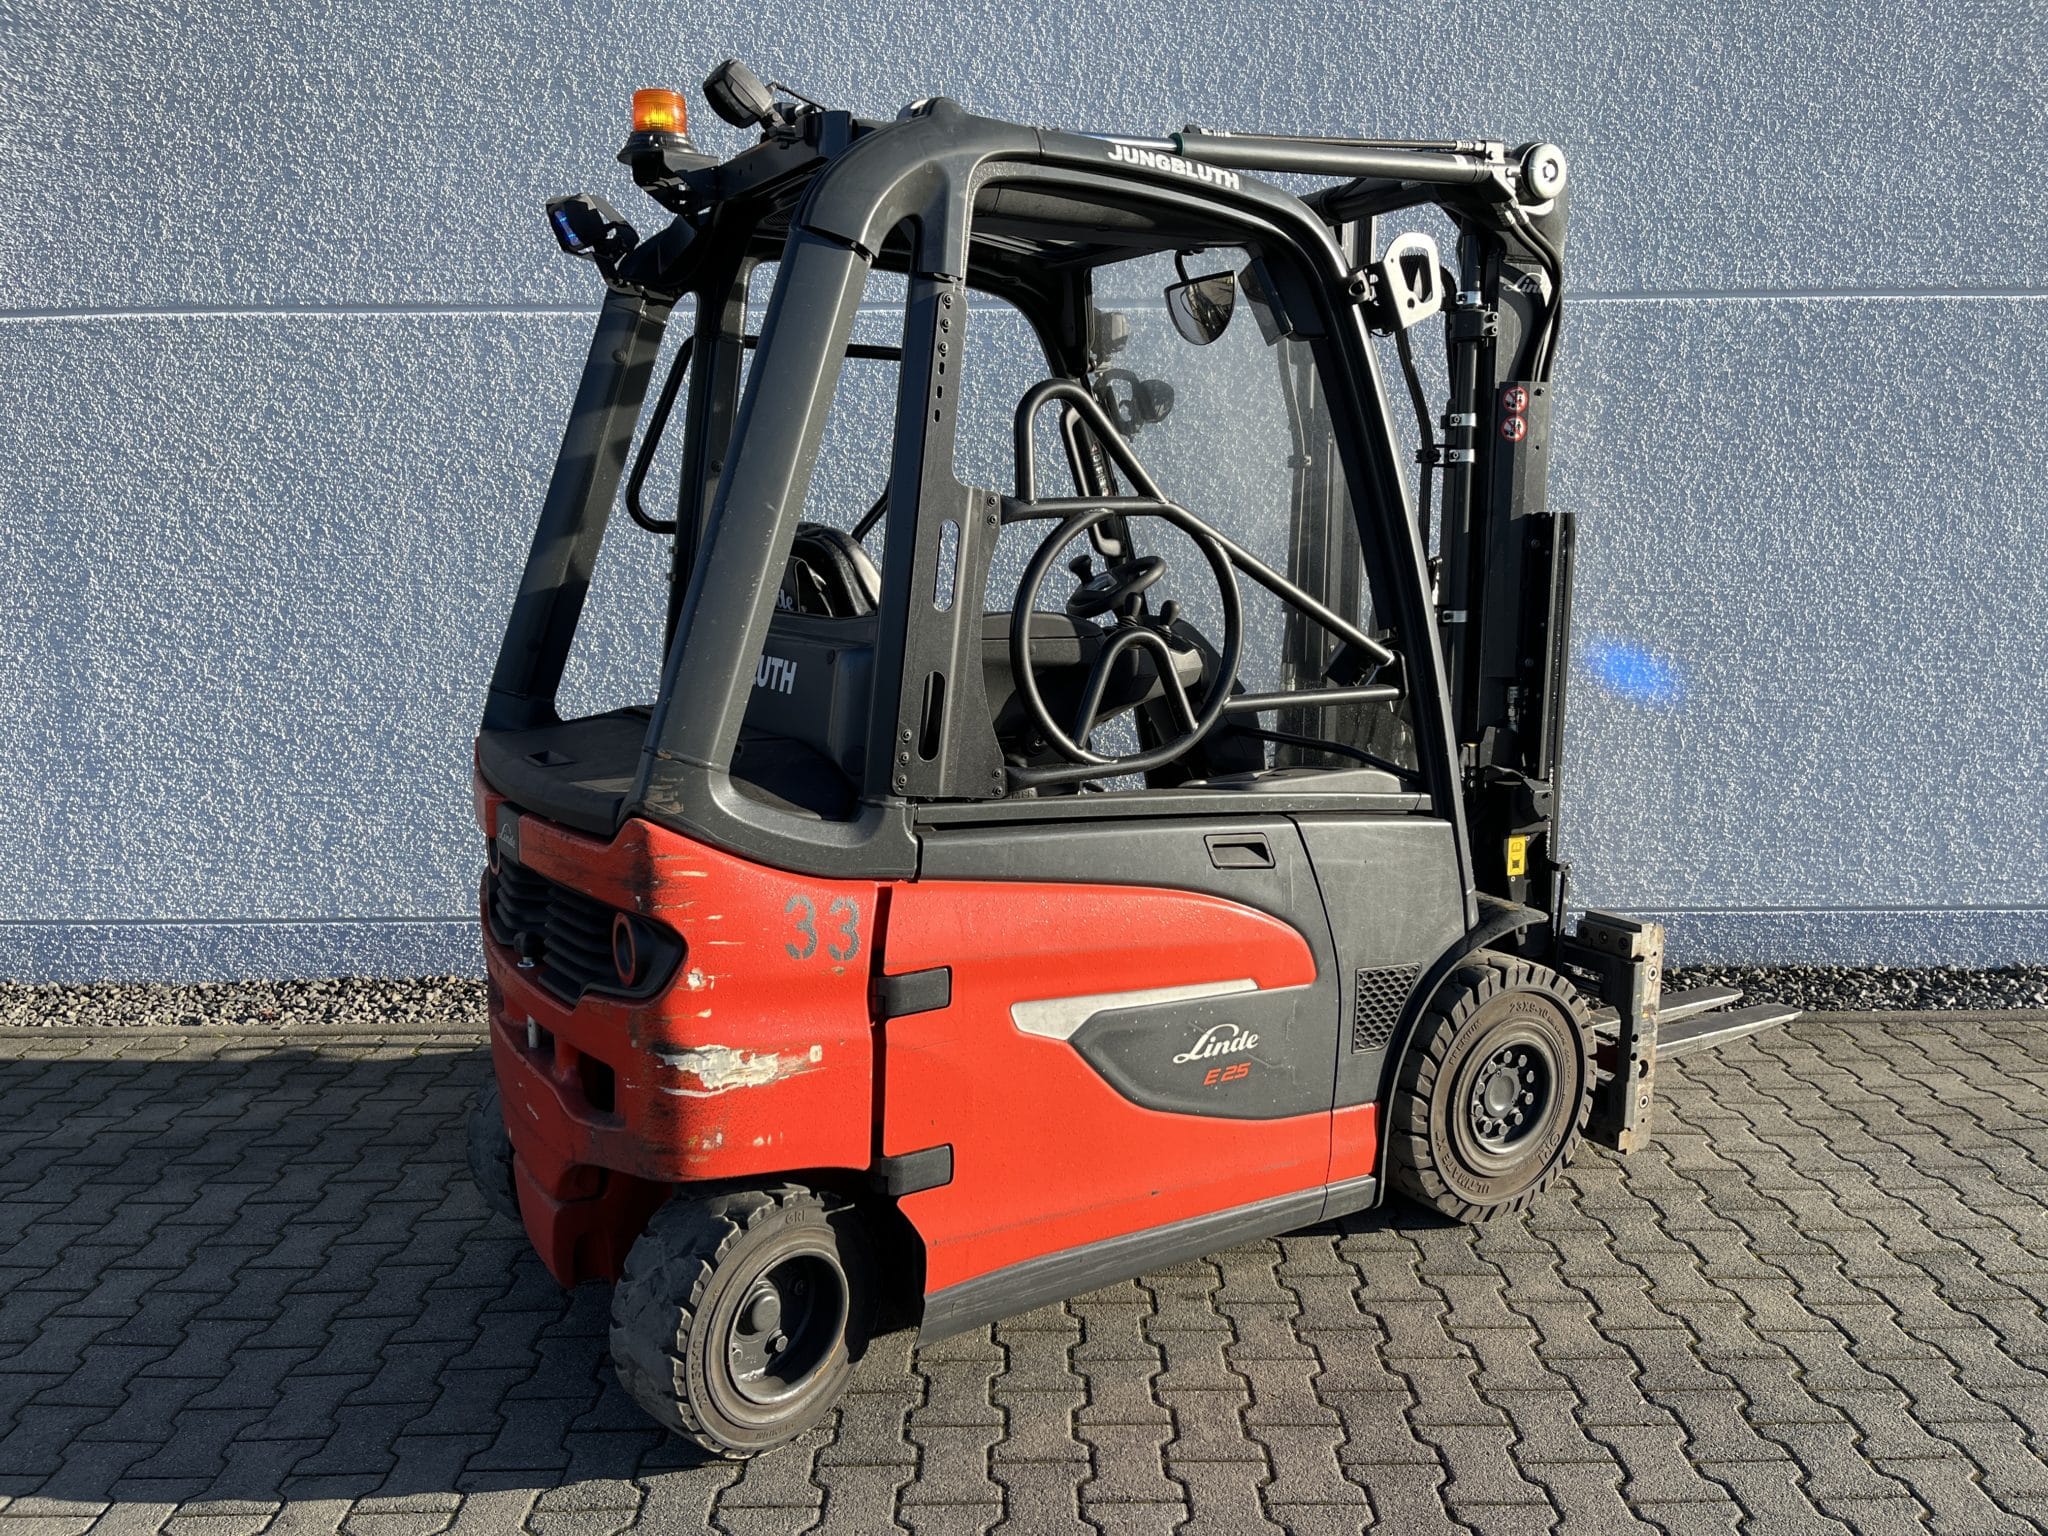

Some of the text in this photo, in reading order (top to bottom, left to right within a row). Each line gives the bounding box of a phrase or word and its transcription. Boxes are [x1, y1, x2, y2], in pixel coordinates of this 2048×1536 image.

[1108, 144, 1240, 190] JUNGBLUTH
[753, 654, 797, 695] UTH
[785, 894, 861, 961] 33
[1172, 1023, 1260, 1064] Linde
[1203, 1061, 1252, 1086] E 25
